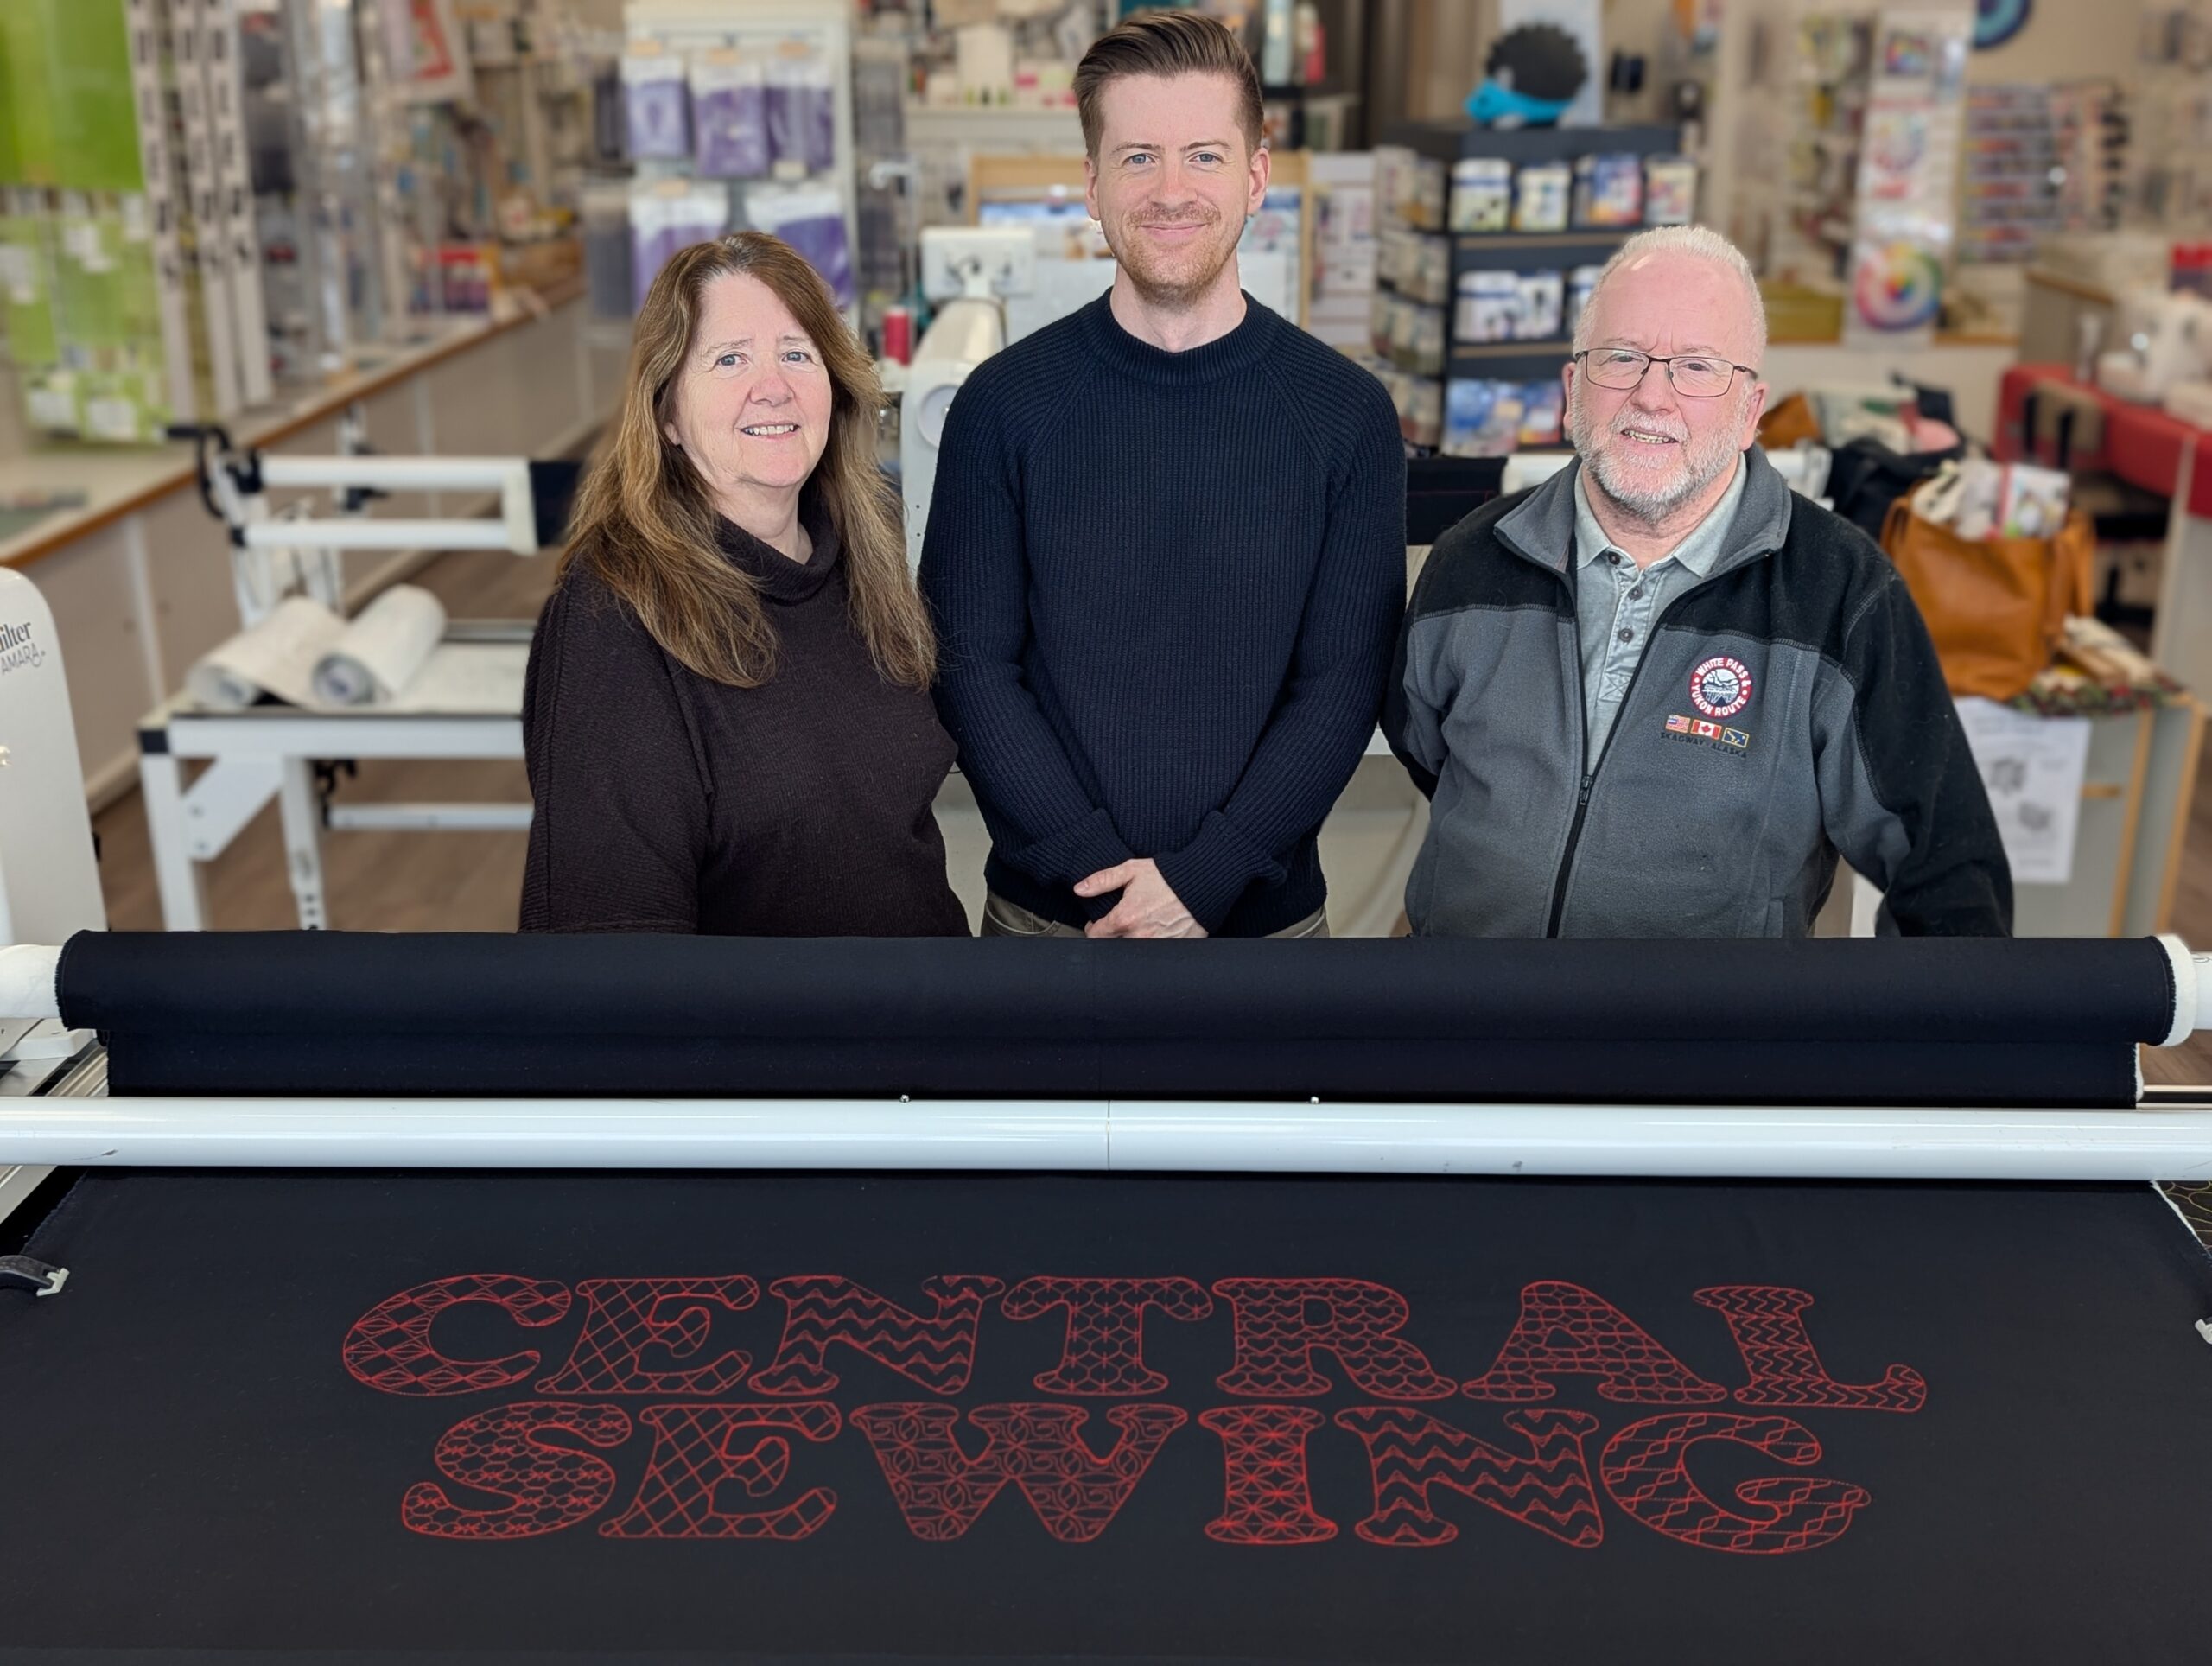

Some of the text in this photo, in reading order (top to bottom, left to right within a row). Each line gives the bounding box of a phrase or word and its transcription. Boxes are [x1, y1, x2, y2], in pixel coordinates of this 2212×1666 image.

[1695, 657, 1752, 688] WHITE PASS &
[1691, 685, 1746, 717] YUKON ROUTE
[1660, 733, 1747, 758] SKAGWAY ALASKA
[343, 1274, 1927, 1413] CENTRAL
[402, 1401, 1872, 1555] SEWING
